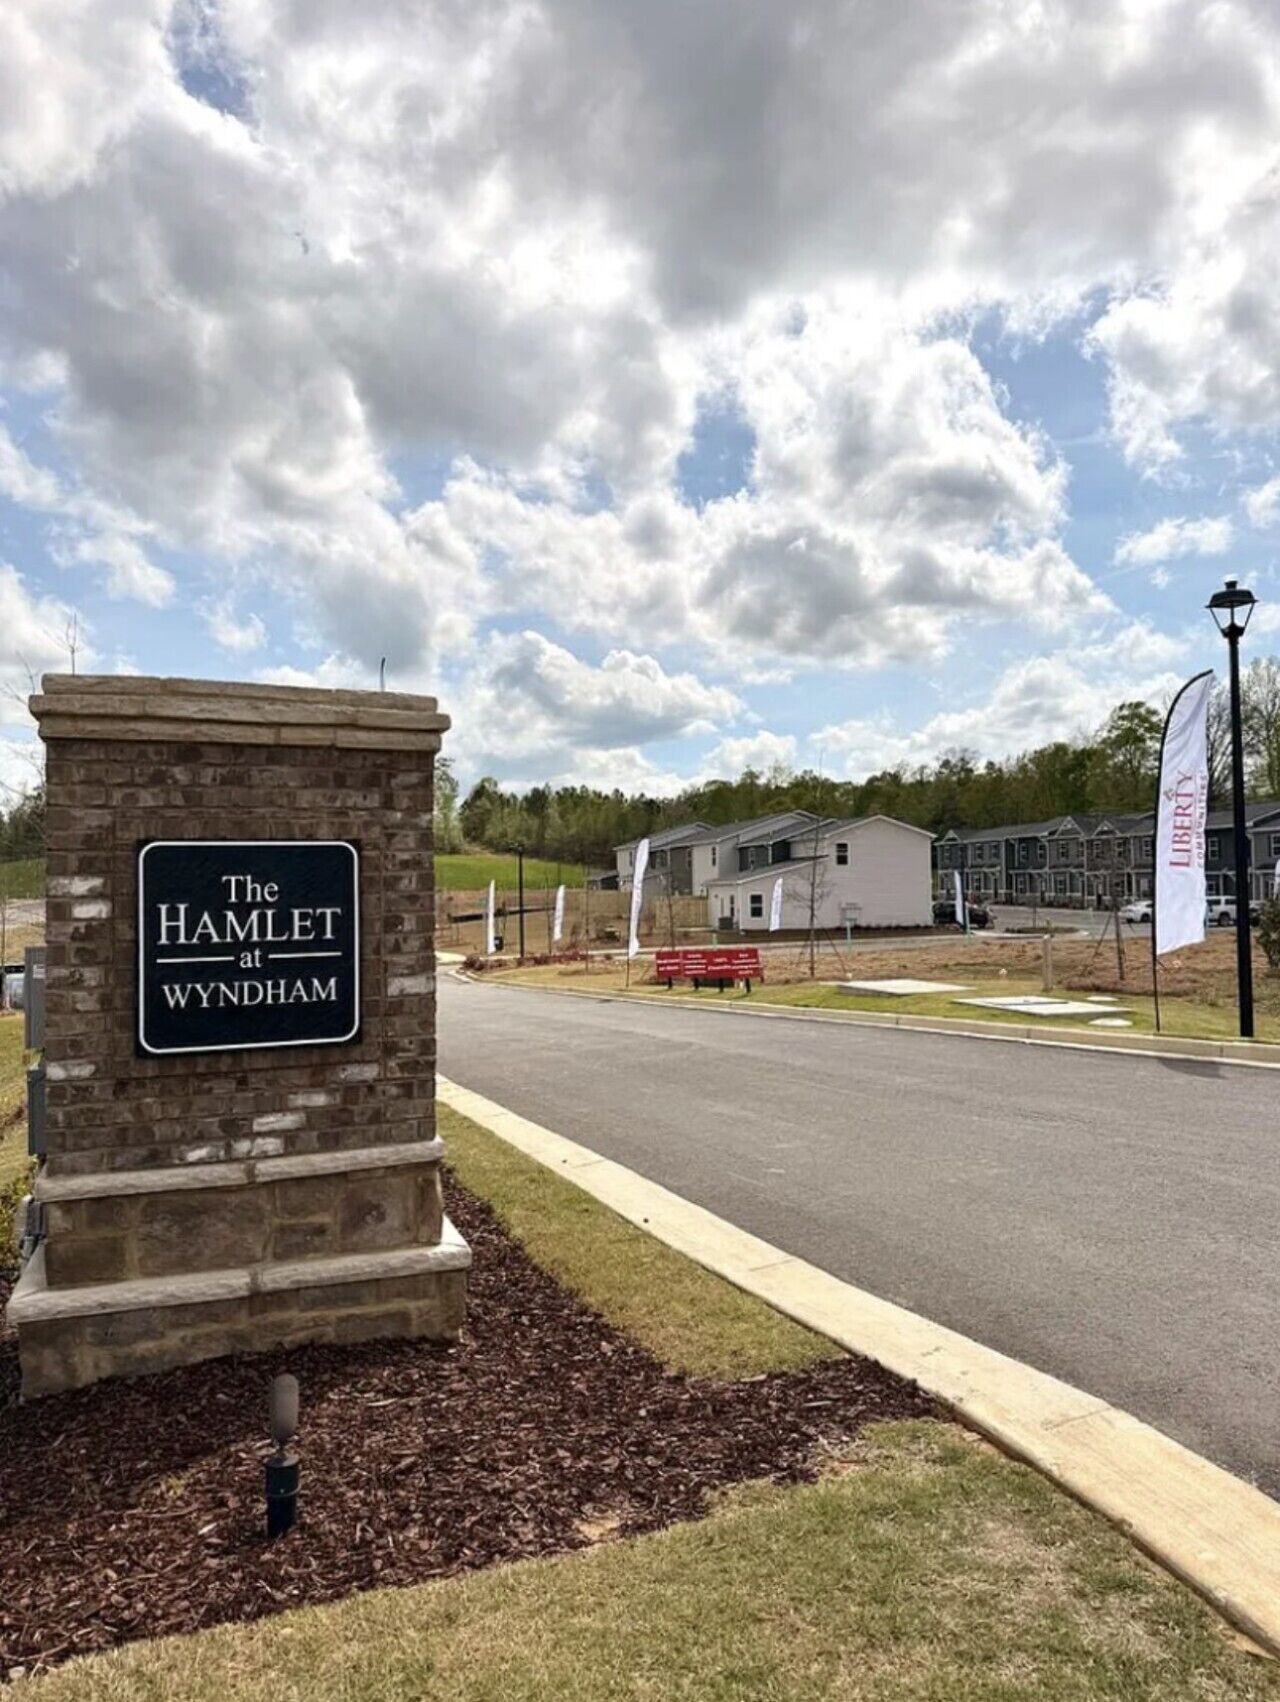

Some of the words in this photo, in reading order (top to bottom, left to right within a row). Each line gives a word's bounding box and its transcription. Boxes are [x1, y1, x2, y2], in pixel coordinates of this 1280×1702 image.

[1169, 769, 1193, 867] LIBERTY
[1196, 774, 1207, 868] COMMUNITIES
[222, 875, 279, 903] The
[156, 903, 342, 945] HAMLET
[239, 948, 263, 968] at
[162, 977, 338, 1010] WYNDHAM
